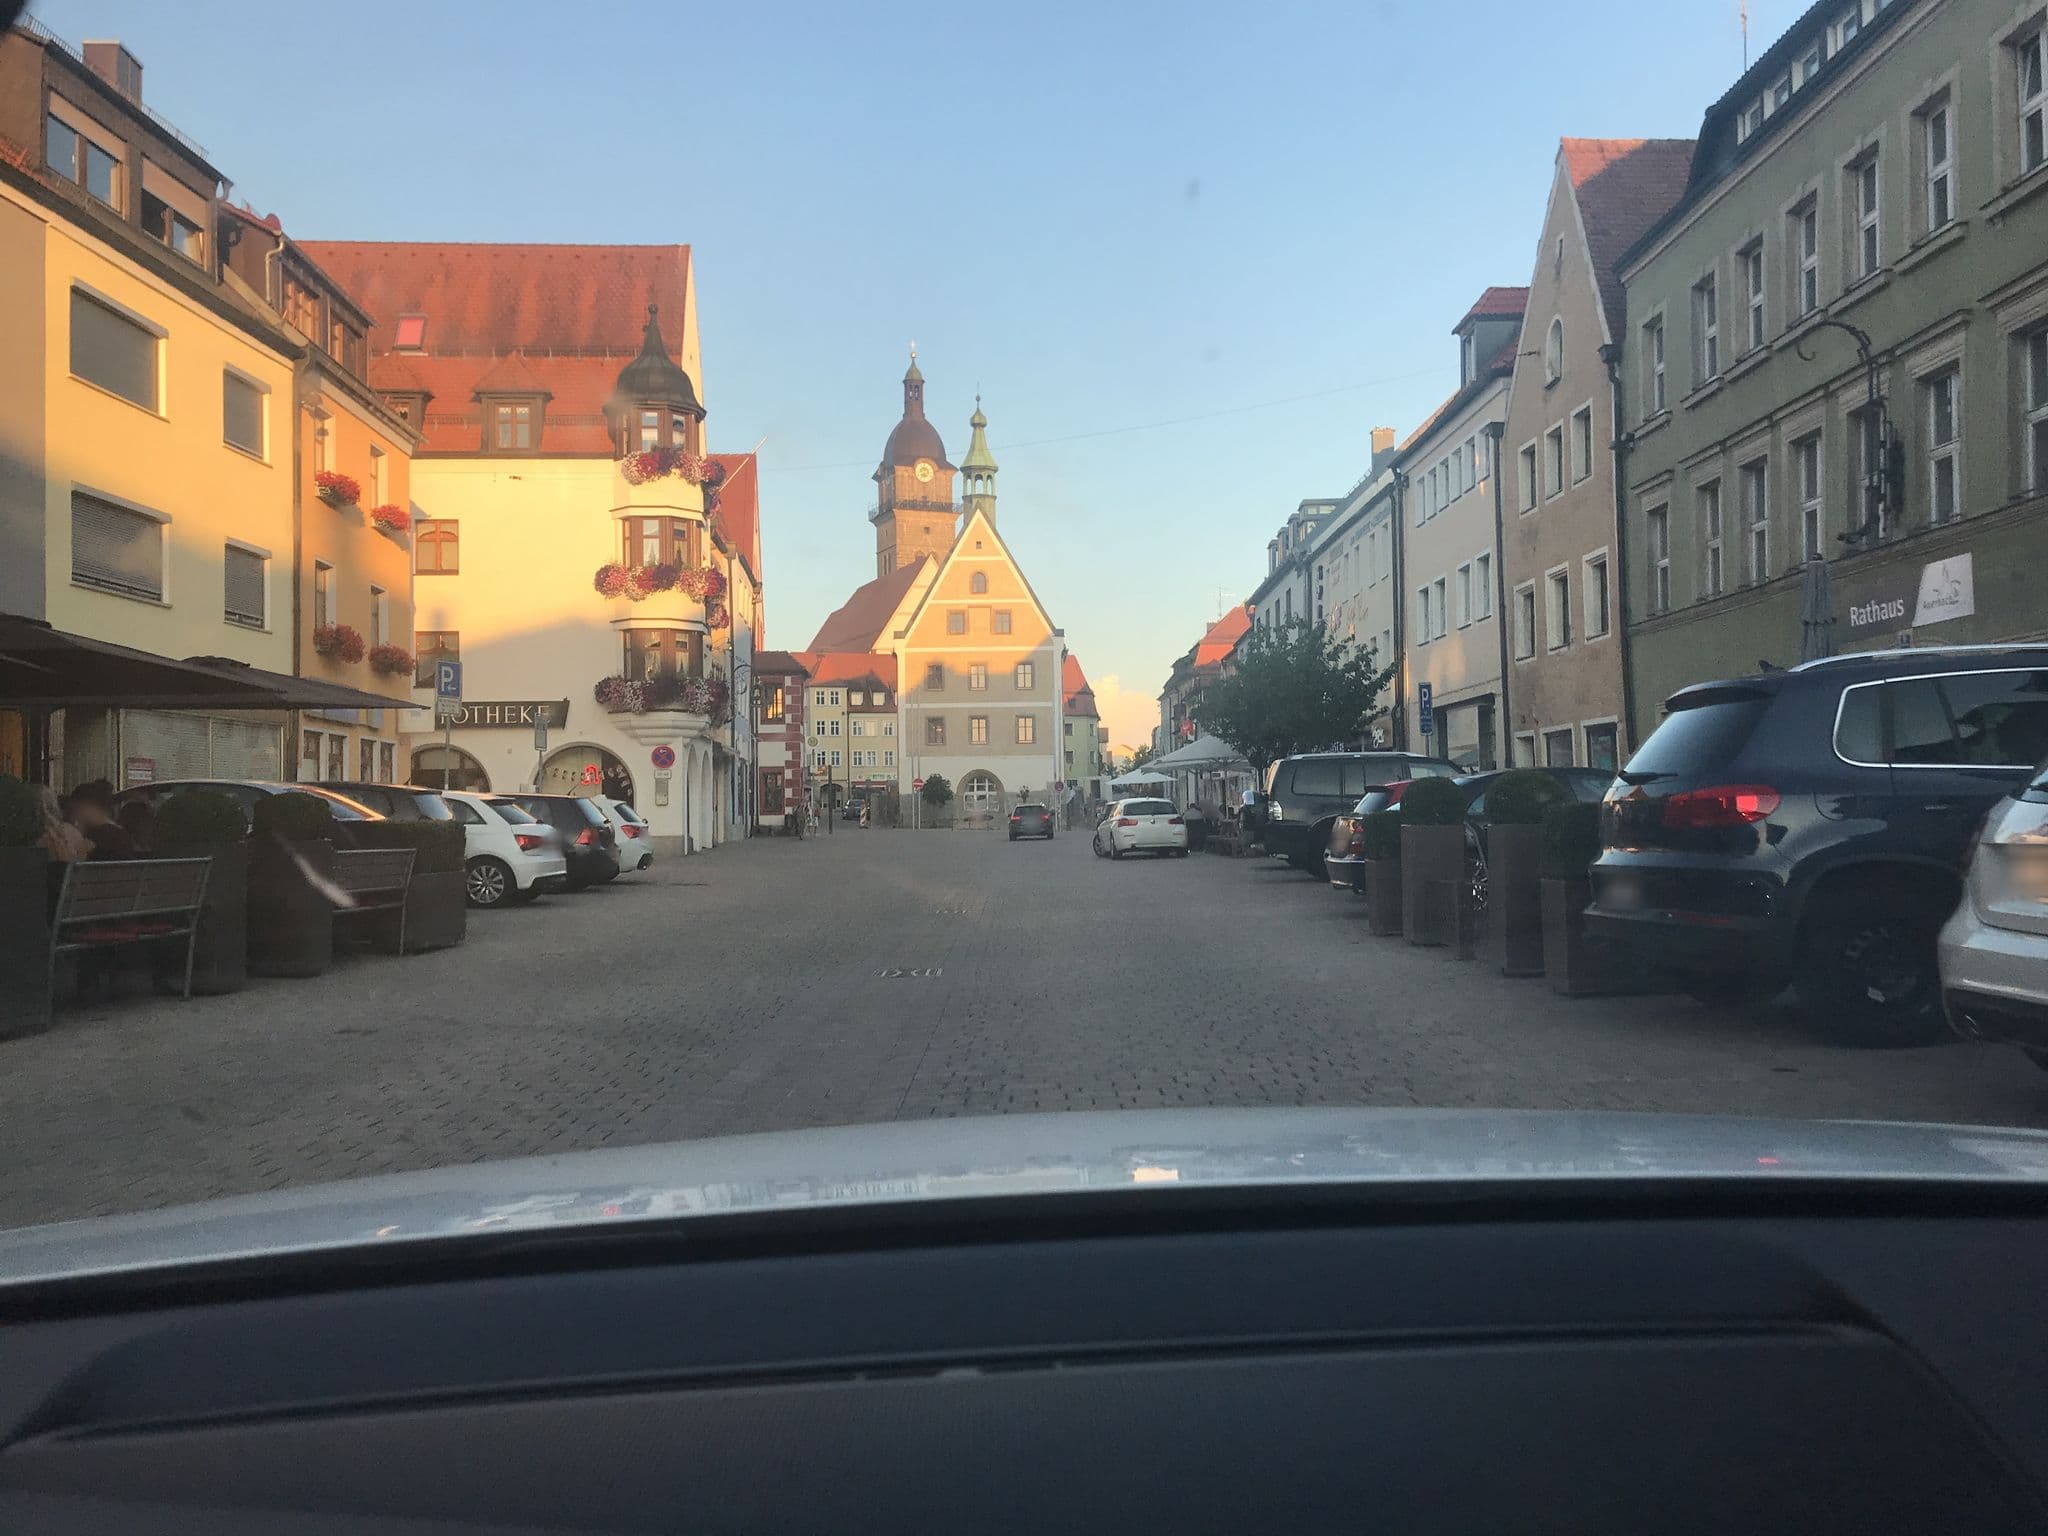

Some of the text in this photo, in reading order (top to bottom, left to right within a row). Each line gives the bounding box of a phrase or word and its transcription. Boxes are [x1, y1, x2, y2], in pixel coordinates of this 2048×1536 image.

[1850, 599, 1904, 627] Rathaus
[441, 665, 454, 692] P
[1421, 688, 1429, 710] P
[440, 705, 550, 724] OTHEKE
